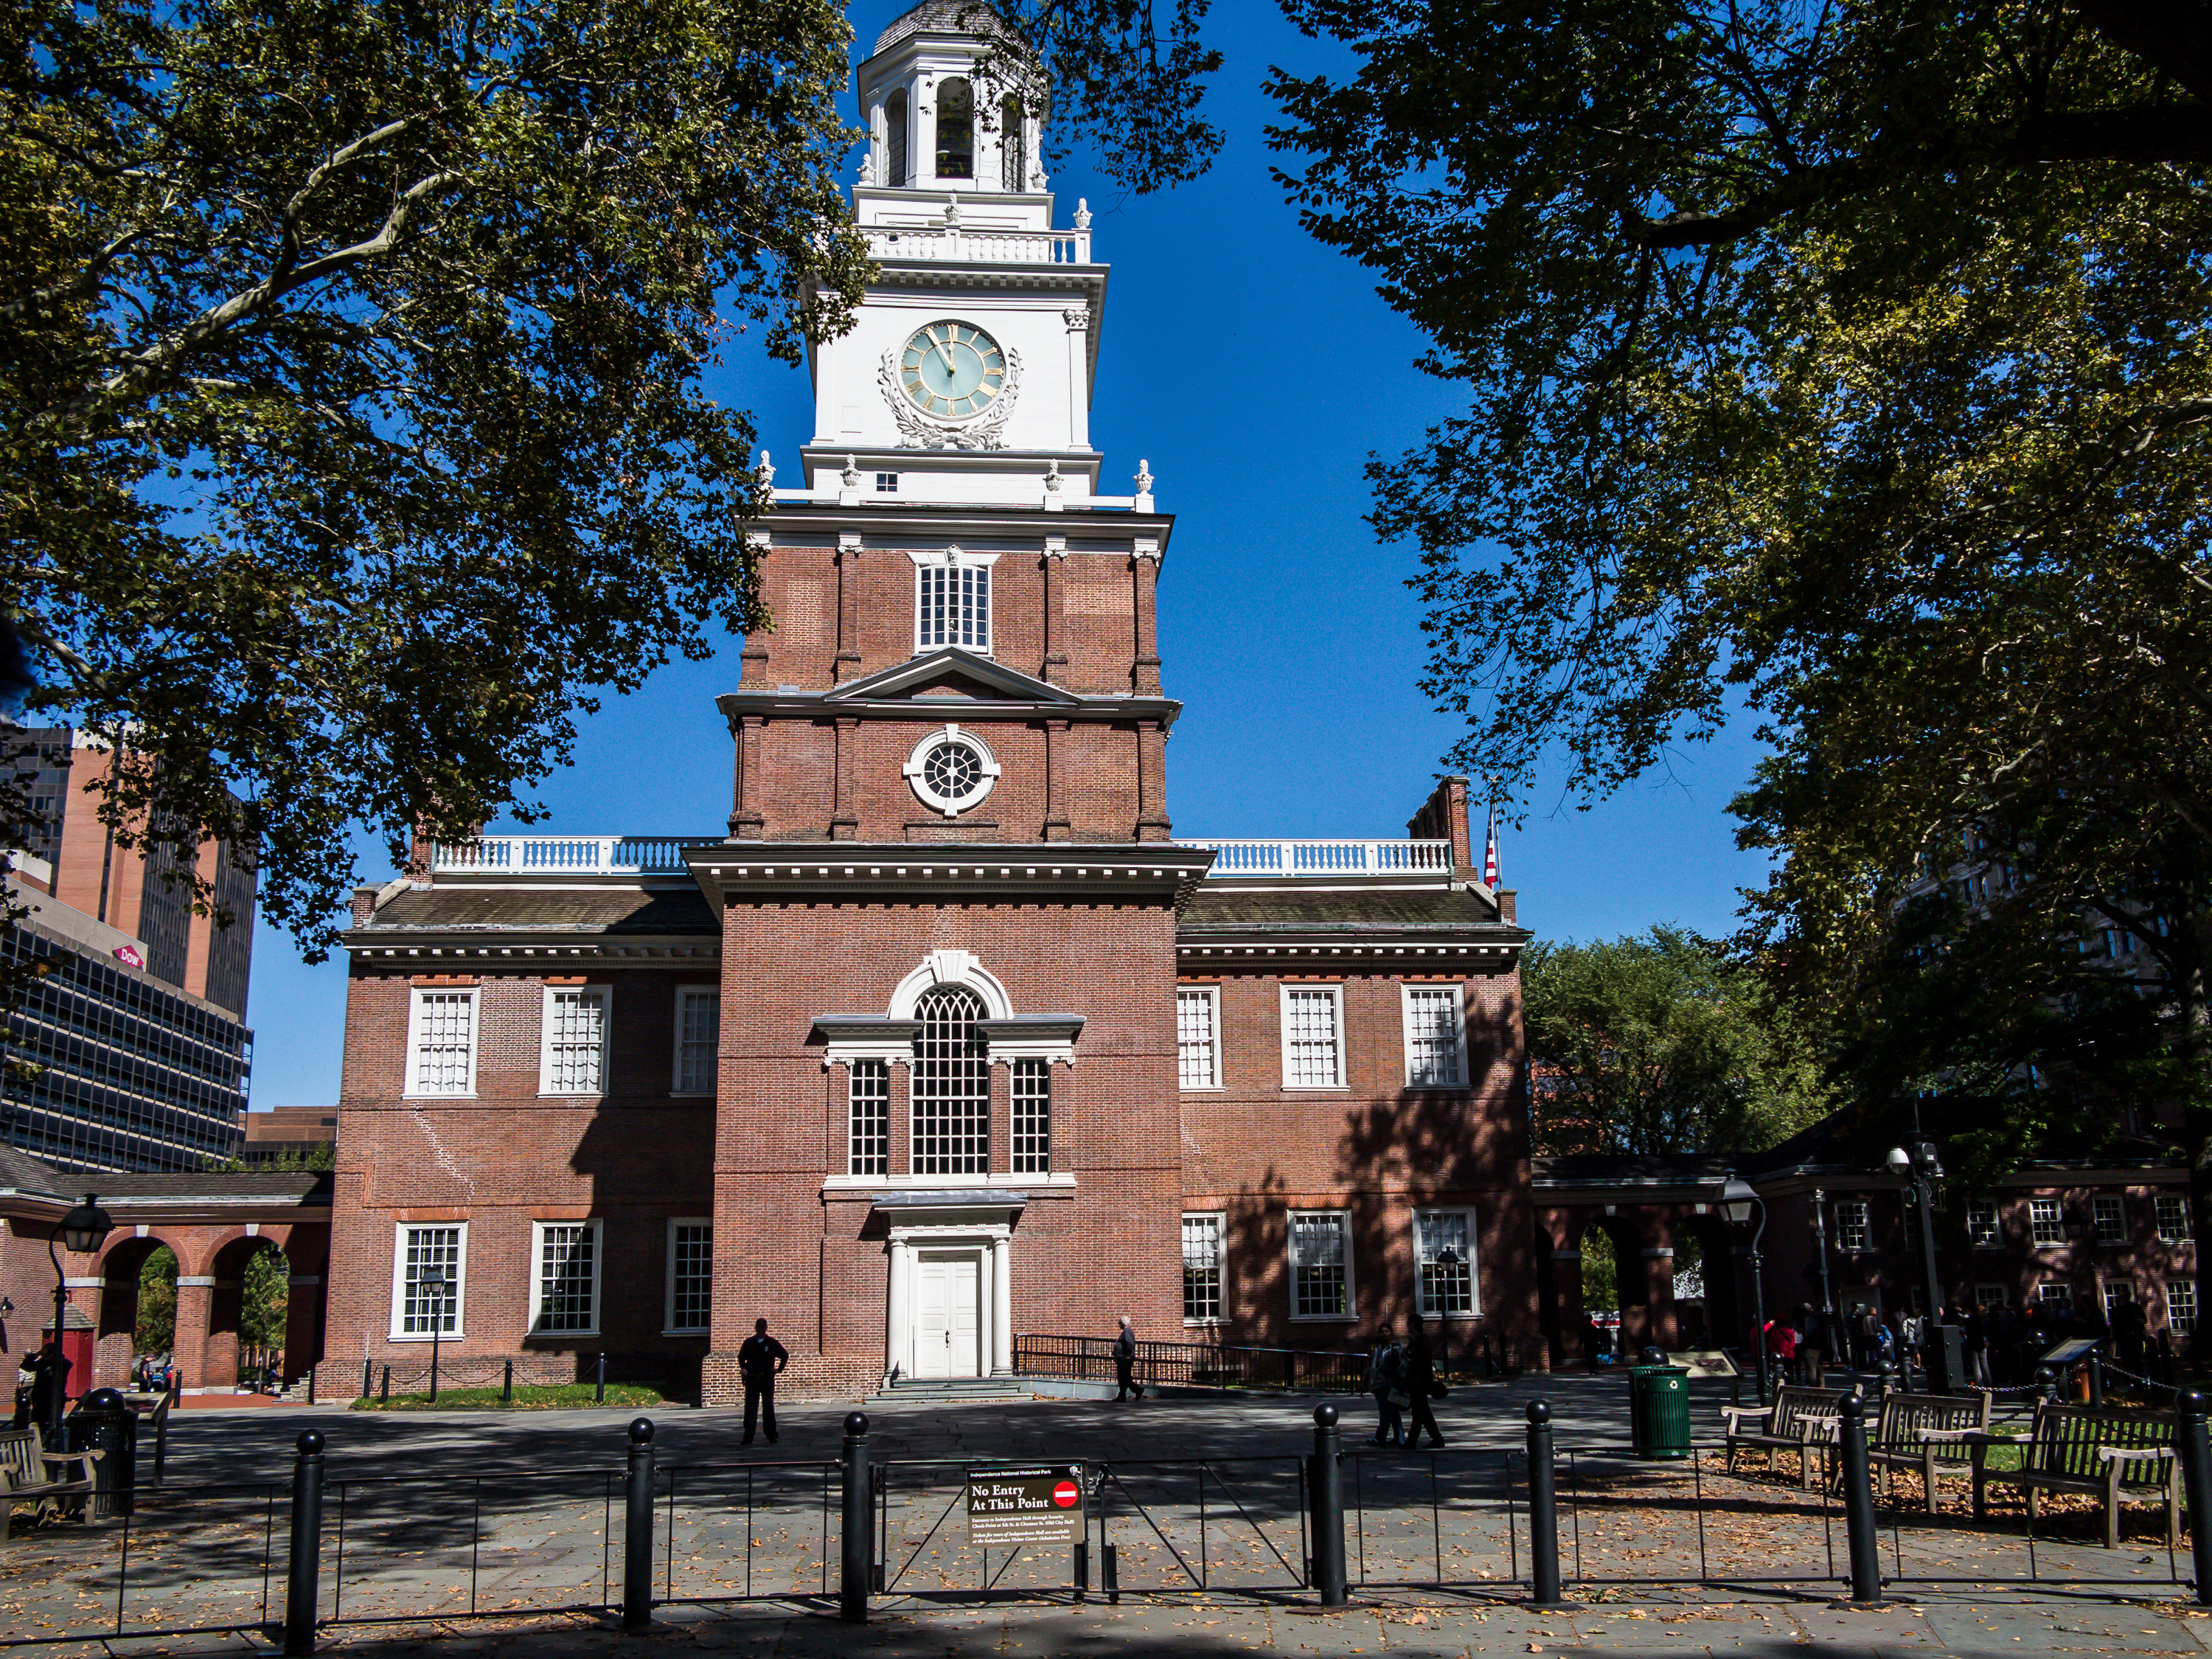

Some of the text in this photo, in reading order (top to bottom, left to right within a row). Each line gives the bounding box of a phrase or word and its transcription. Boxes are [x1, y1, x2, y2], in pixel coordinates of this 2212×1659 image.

[972, 1484, 1025, 1498] No Entry
[972, 1497, 1048, 1511] At This Point
